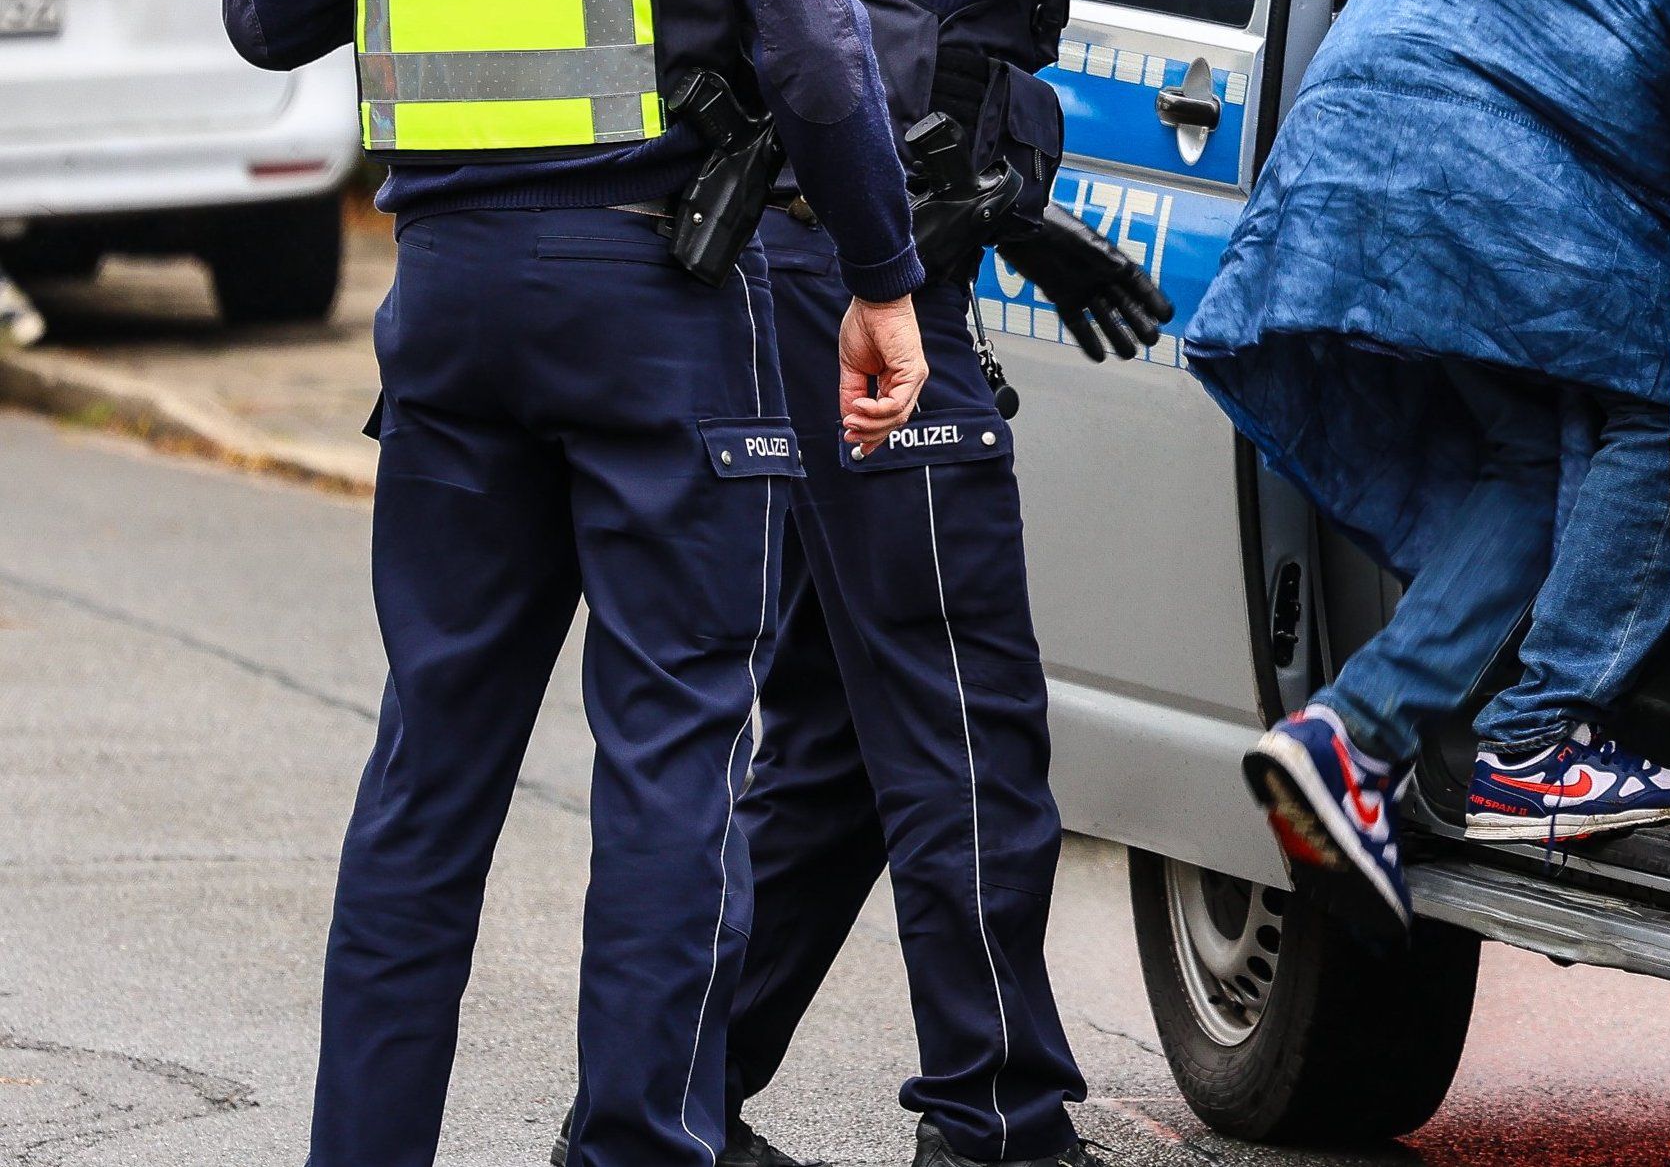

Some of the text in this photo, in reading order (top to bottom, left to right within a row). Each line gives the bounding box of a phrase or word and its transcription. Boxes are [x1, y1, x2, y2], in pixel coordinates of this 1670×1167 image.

[745, 436, 790, 457] POLIZEI
[888, 425, 960, 450] POLIZEI
[1469, 794, 1485, 805] AIR
[1485, 799, 1517, 814] SPAN
